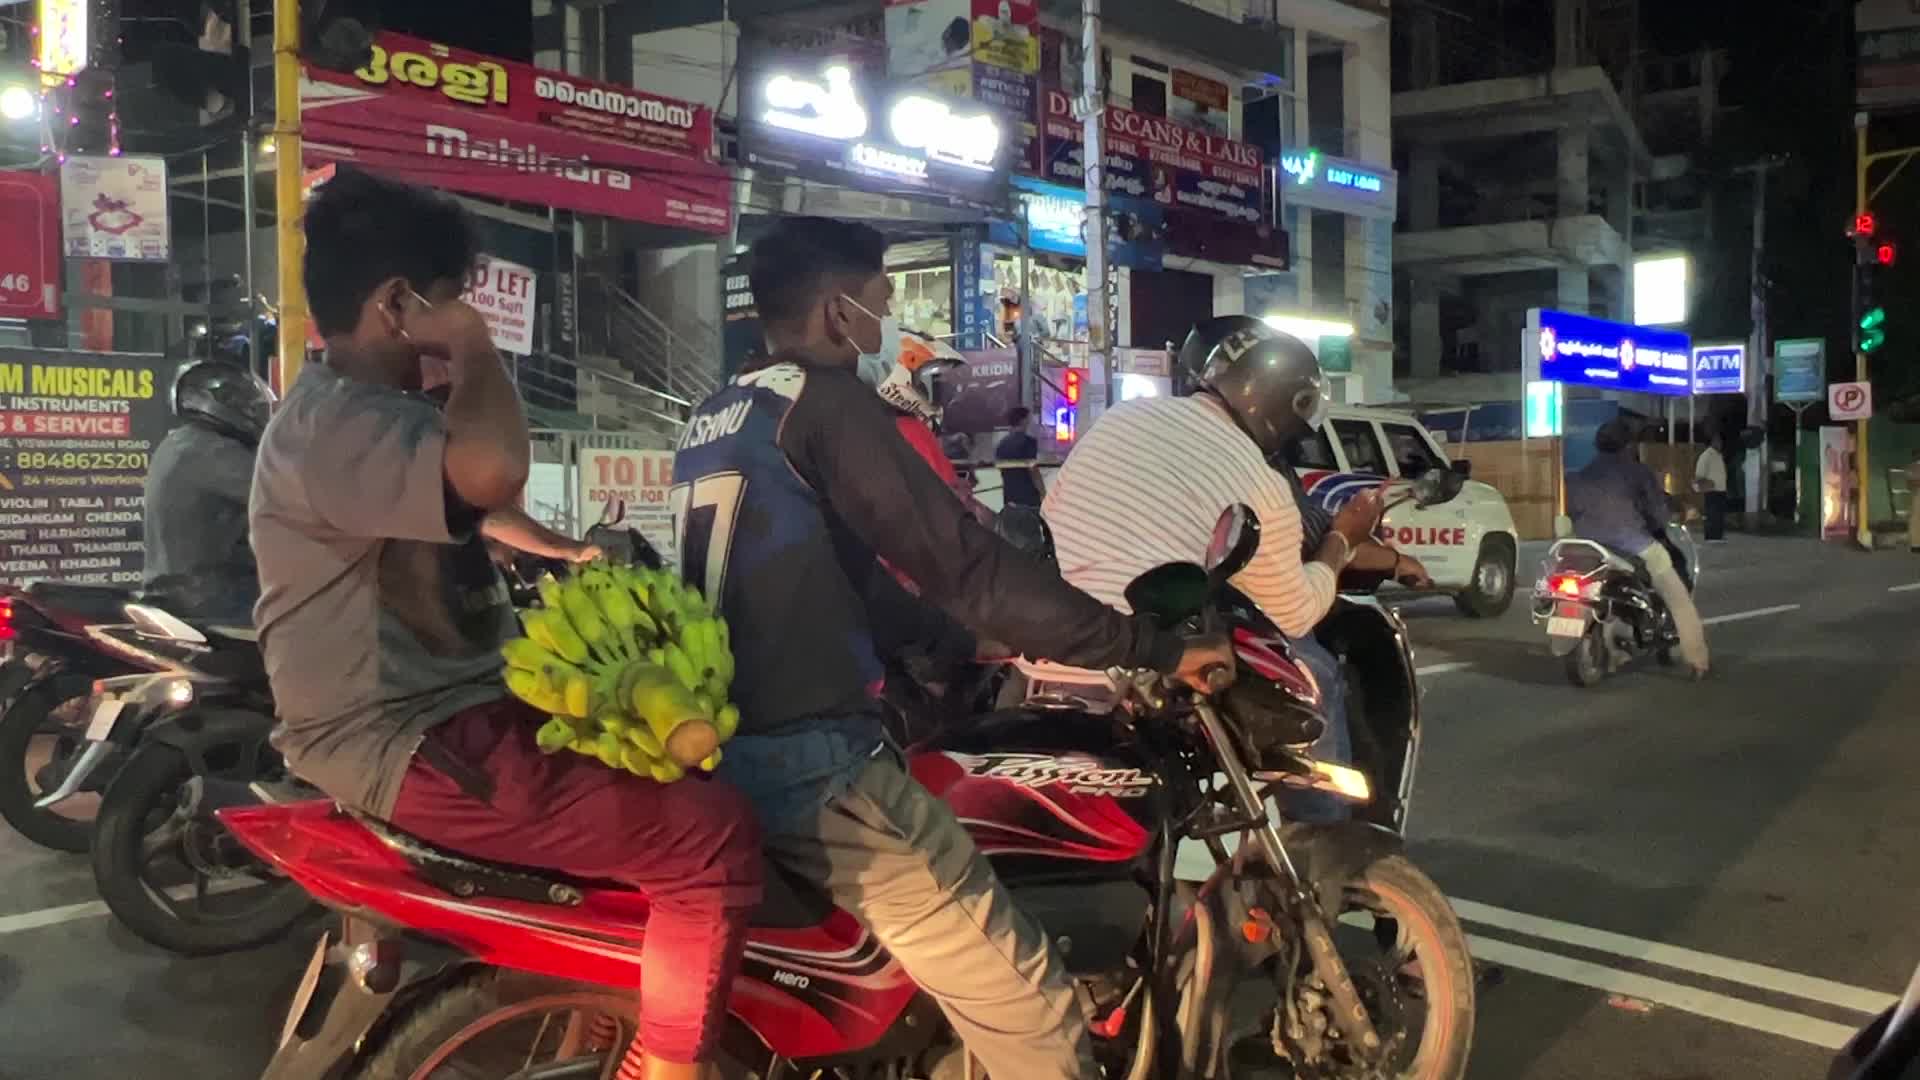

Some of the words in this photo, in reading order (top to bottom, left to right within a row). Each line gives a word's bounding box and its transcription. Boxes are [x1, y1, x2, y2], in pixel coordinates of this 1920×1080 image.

[1112, 110, 1184, 149] SCANS
[1186, 131, 1201, 153] &
[1206, 136, 1258, 169] LABS
[1, 274, 30, 292] 46
[497, 268, 531, 299] LET
[1697, 353, 1741, 372] ATM
[32, 365, 154, 399] MUSICALS
[11, 397, 130, 413] INSTRUMENTS
[12, 415, 27, 432] &
[33, 416, 125, 434] SERVICE
[16, 451, 150, 470] 8848625201
[594, 455, 635, 487] TO
[643, 456, 673, 488] LE
[22, 475, 41, 486] 24
[44, 475, 87, 487] Hours
[1, 498, 49, 509] VIOLIN
[60, 497, 104, 509] TABLA
[115, 496, 145, 508] FLUT
[641, 489, 665, 503] FOR
[86, 511, 142, 523] CHENDA
[39, 527, 127, 539] HARMONIUM
[1375, 526, 1465, 546] POLICE
[112, 571, 144, 583] BOO
[1069, 785, 1148, 797] PRO
